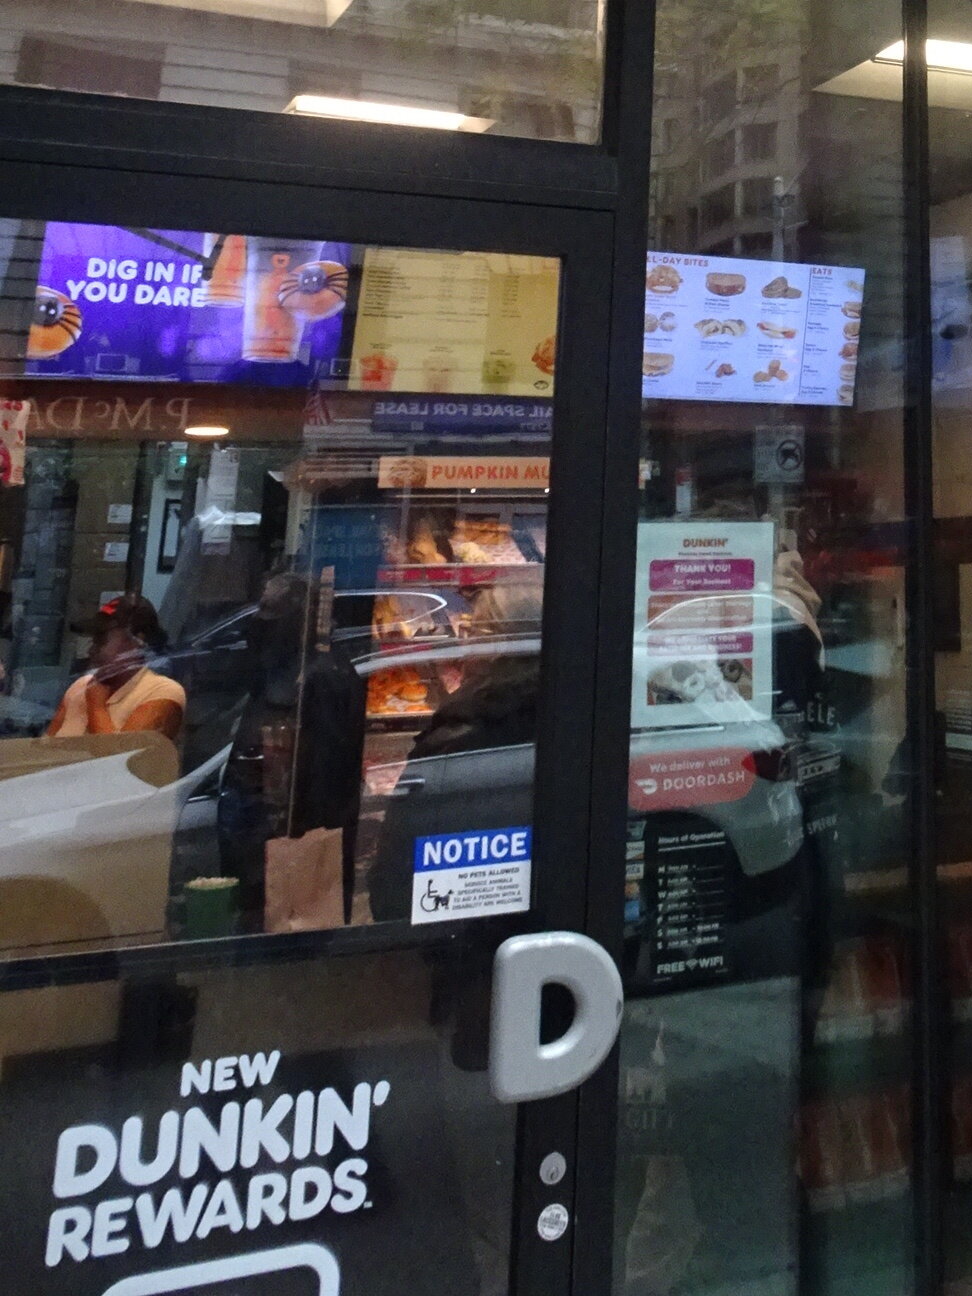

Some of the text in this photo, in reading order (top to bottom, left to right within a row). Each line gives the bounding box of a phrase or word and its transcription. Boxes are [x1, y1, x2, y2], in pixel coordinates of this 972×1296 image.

[87, 257, 203, 284] DIG IN IF
[683, 258, 709, 267] BITES
[66, 279, 208, 308] YOU DARE
[431, 465, 520, 481] PUMPKIN
[682, 537, 728, 548] DUNKIN'
[674, 564, 706, 573] THANK
[649, 756, 731, 773] We deliver with
[663, 771, 745, 791] DOORDASH
[658, 831, 725, 844] Hours of Operation
[423, 832, 527, 866] NOTICE
[470, 870, 486, 878] PETS
[489, 867, 520, 876] ALLOWED
[657, 956, 723, 974] FREE WIFI
[180, 1050, 281, 1097] NEW
[52, 1080, 391, 1199] DUNKIN'
